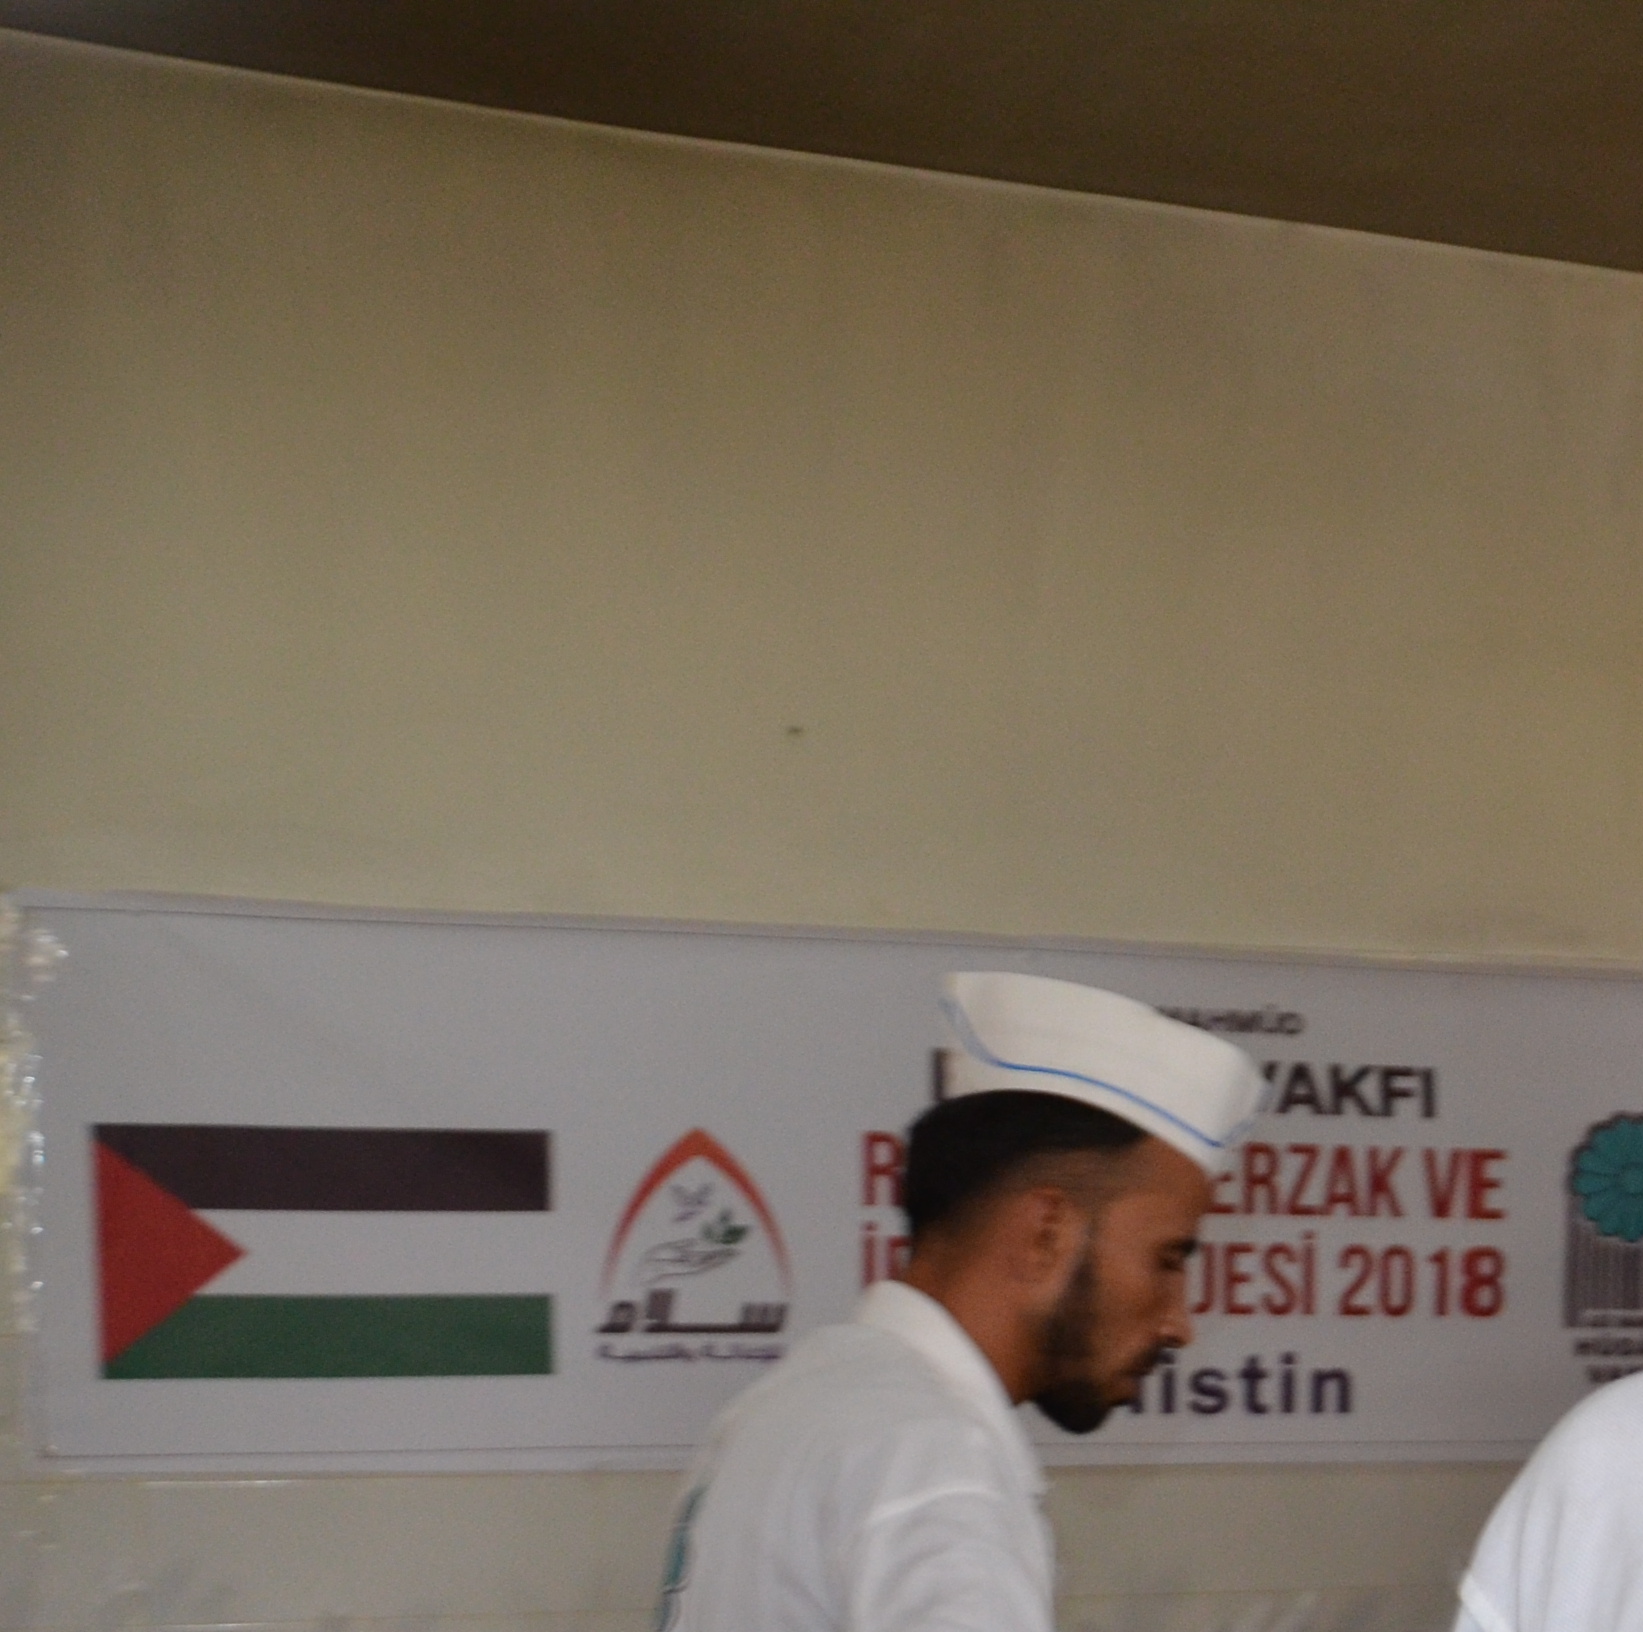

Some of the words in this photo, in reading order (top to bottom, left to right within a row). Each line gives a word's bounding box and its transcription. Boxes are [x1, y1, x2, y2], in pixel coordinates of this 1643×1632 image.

[1262, 1061, 1438, 1118] AKFI
[1423, 1148, 1506, 1221] VE
[1337, 1245, 1506, 1318] 2018
